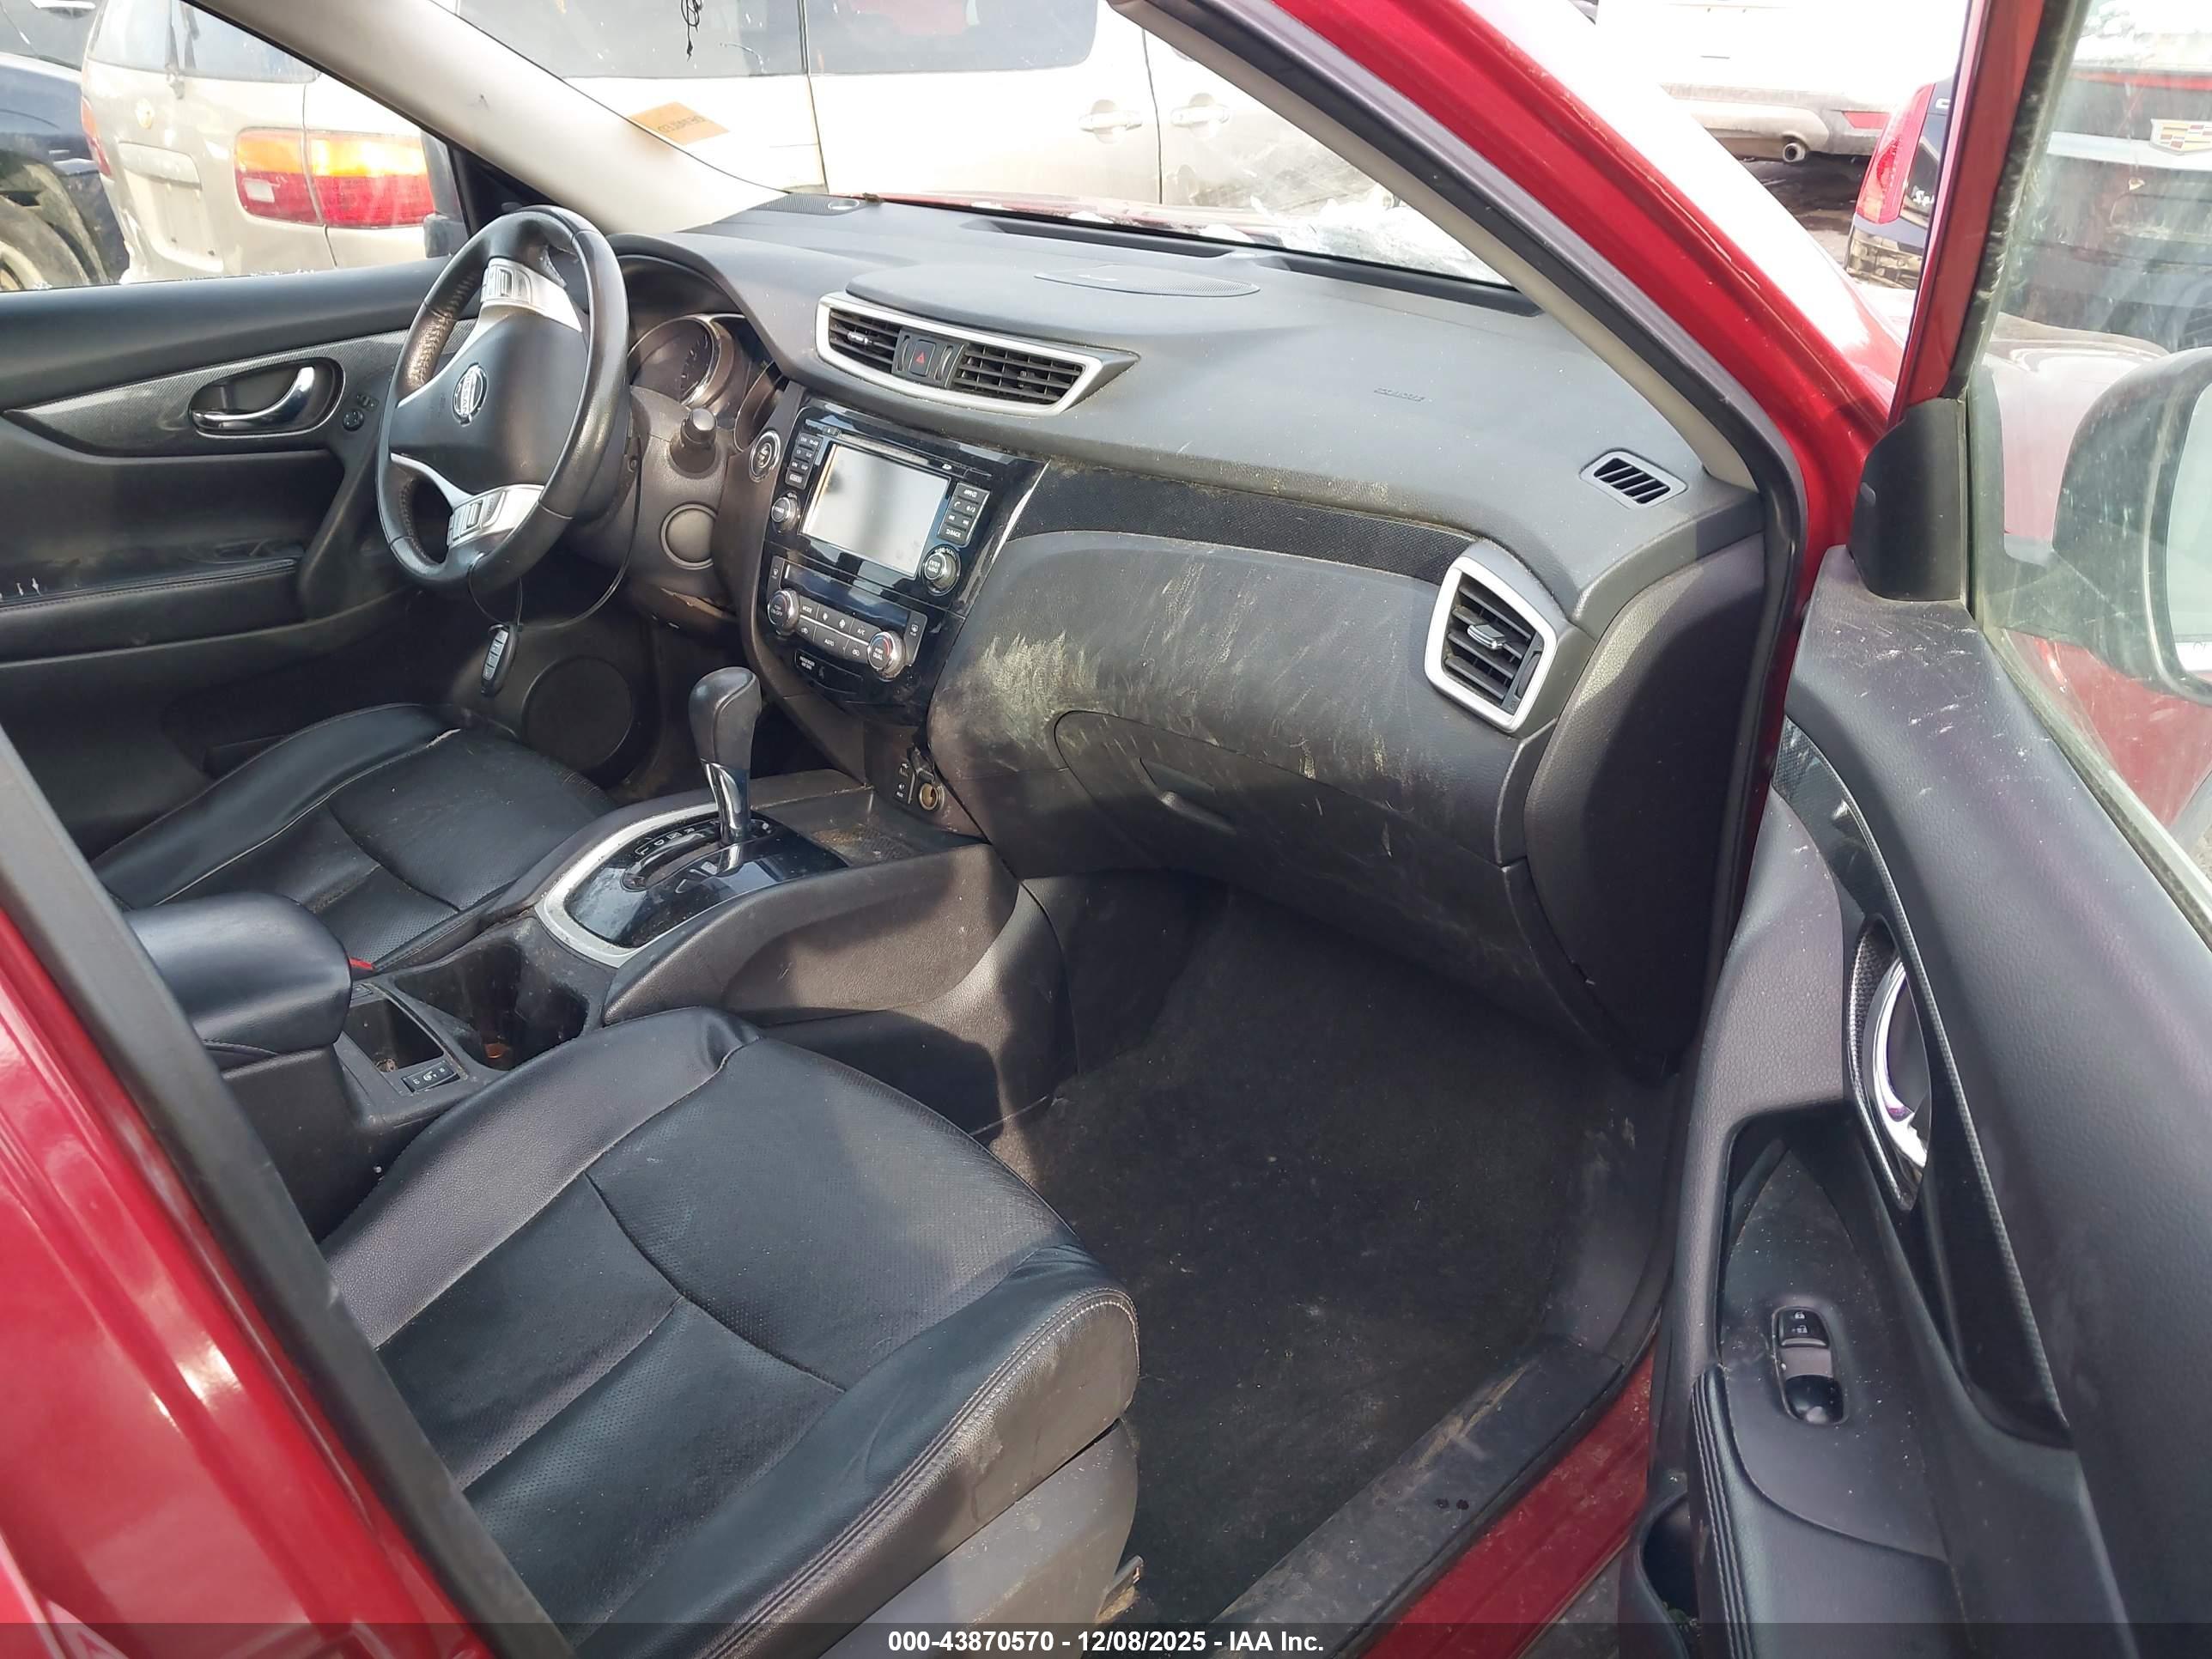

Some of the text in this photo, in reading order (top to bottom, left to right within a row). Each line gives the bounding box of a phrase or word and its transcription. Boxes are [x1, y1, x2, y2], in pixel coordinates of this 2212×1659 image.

[802, 605, 813, 614] MODE
[857, 627, 866, 636] A/C
[823, 638, 835, 647] AUTO
